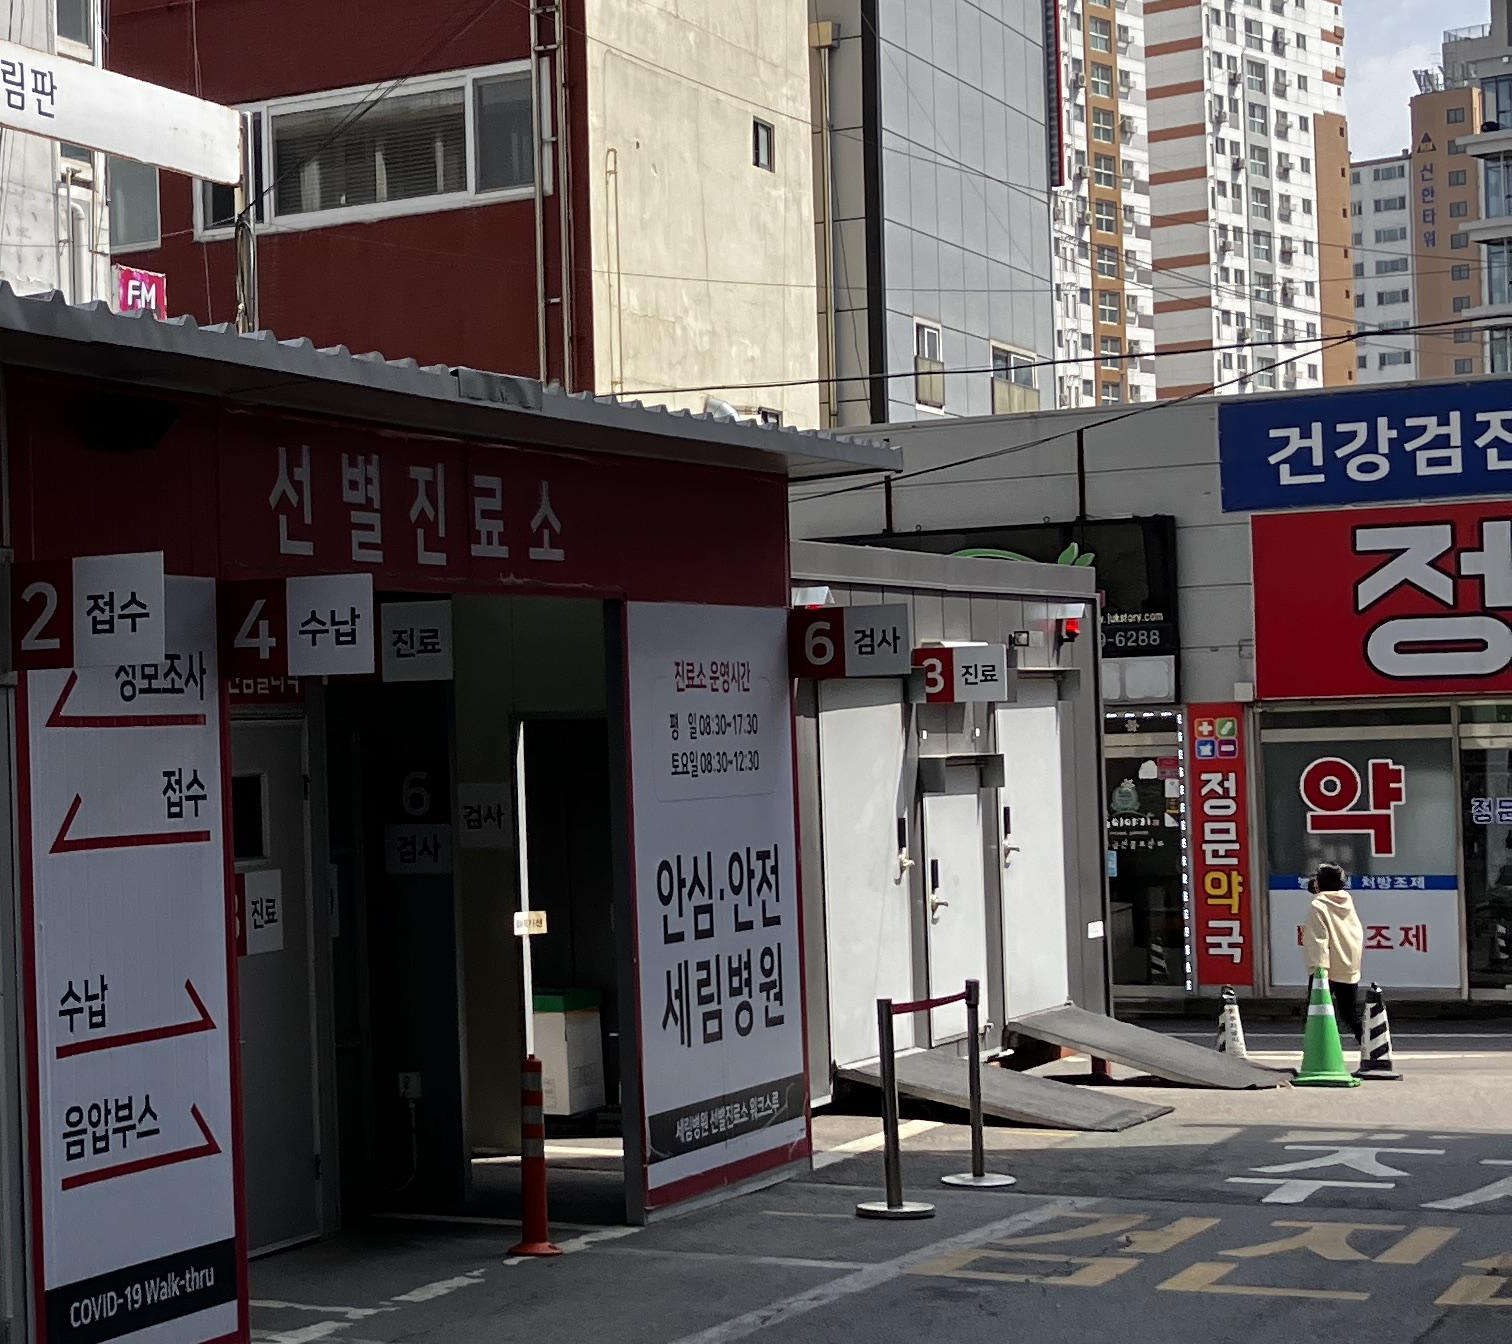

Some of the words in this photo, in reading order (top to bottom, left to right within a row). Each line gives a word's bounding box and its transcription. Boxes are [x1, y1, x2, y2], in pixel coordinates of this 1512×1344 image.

[128, 279, 156, 309] FM
[269, 444, 565, 566] 선별진료소
[21, 582, 60, 651] 2
[86, 591, 150, 634] 접수
[1352, 518, 1512, 679] 정
[234, 599, 277, 659] 4
[299, 606, 360, 646] 수납
[392, 627, 441, 658] 진료
[804, 621, 834, 665] 6
[854, 626, 900, 656] 검사
[674, 660, 707, 692] 진료소
[710, 661, 750, 693] 운영시간
[925, 658, 945, 693] 3
[961, 664, 999, 686] 진료
[671, 750, 698, 777] 토요일
[162, 768, 207, 819] 접수
[401, 770, 432, 817] 6
[1300, 756, 1406, 857] 약
[464, 804, 504, 830] 검사
[396, 833, 440, 864] 검사
[1200, 771, 1244, 964] 정문약국
[1362, 875, 1425, 889] 처방조제
[251, 898, 277, 929] 진료
[59, 975, 108, 1032] 수납
[662, 942, 785, 1048] 세림병원
[62, 1094, 160, 1161] 음압부스
[675, 1112, 709, 1143] 세림병원
[710, 1101, 749, 1134] 선별진료소
[70, 1280, 143, 1329] COVID-19
[144, 1265, 215, 1301] Walk-thru
